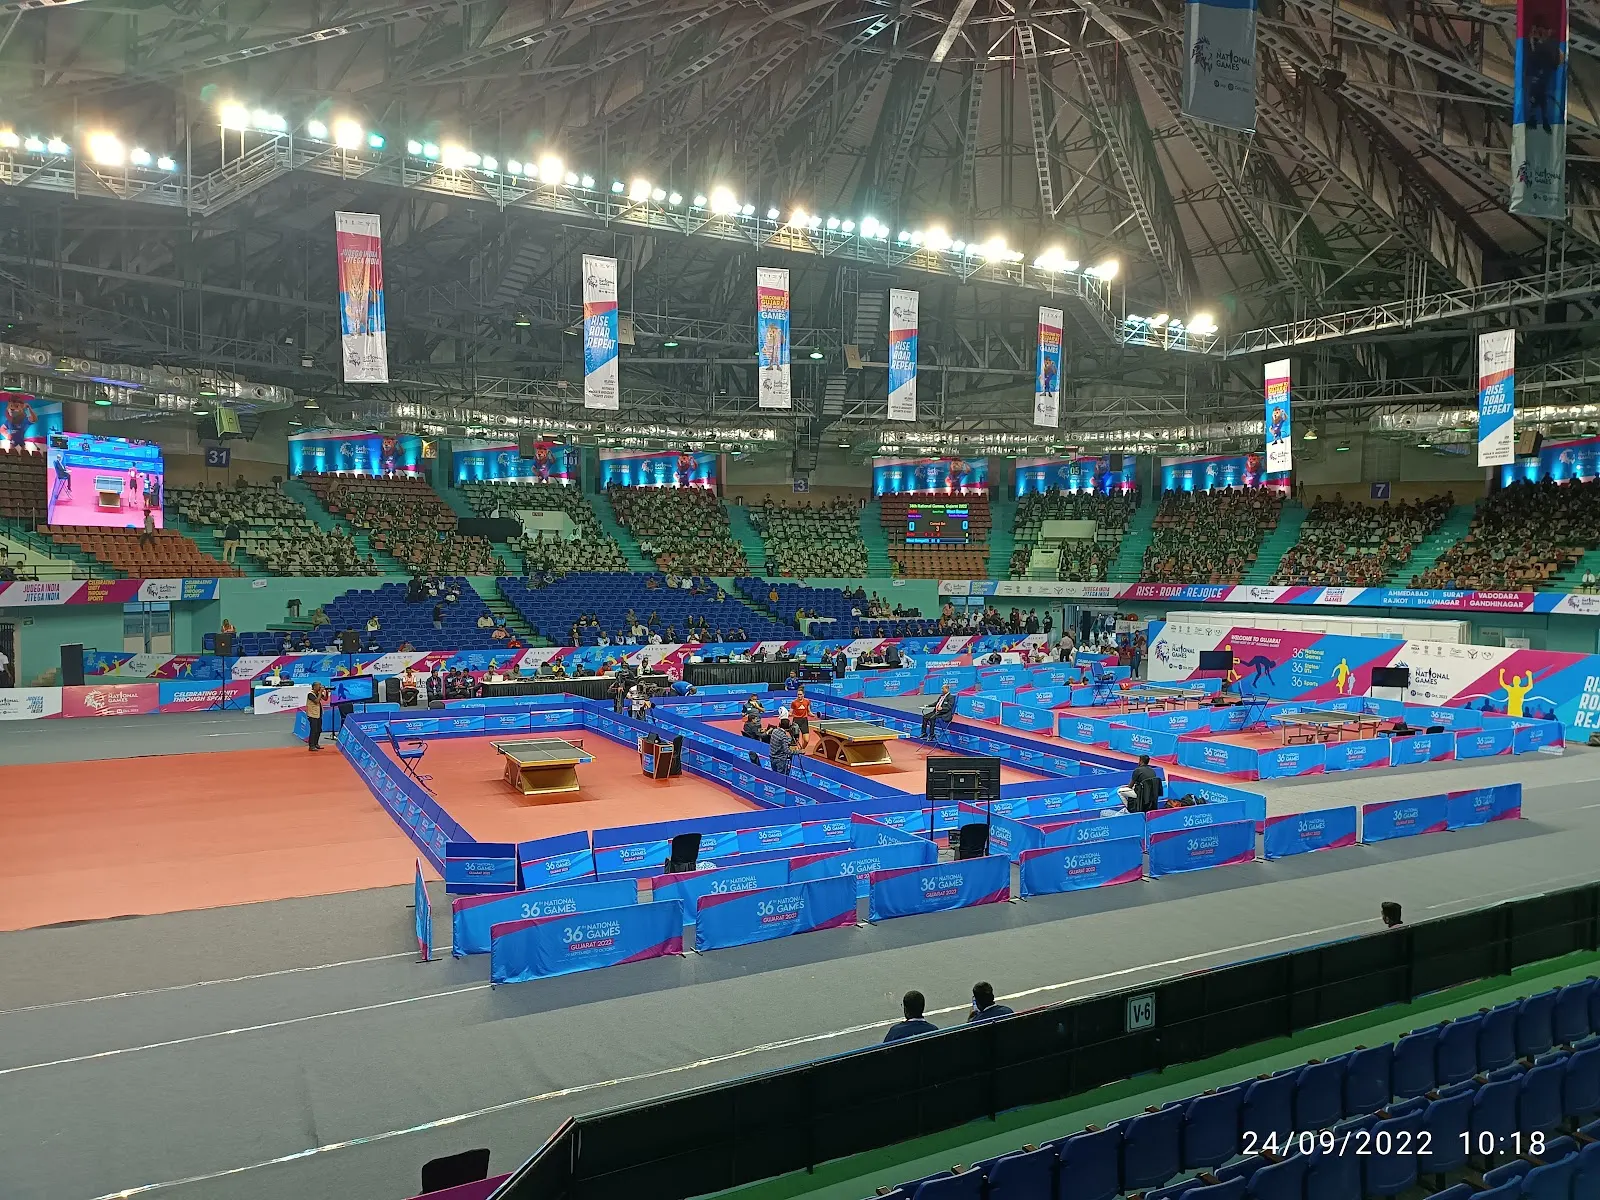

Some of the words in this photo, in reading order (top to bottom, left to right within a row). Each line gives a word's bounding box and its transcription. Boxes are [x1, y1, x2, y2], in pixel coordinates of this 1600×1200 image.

[1216, 49, 1251, 66] NATIONAL
[1216, 60, 1239, 71] GAMES
[591, 314, 609, 327] RISE
[761, 311, 786, 320] GAMES
[589, 325, 610, 338] ROAR
[587, 336, 616, 350] REPEAT
[895, 341, 910, 351] RISE
[893, 350, 911, 361] ROAR
[891, 360, 915, 371] REPEAT
[1485, 383, 1504, 395] RISE
[1483, 393, 1505, 406] ROAR
[1482, 403, 1512, 416] REPEAT
[208, 449, 227, 465] 31
[1070, 466, 1080, 475] 05
[799, 480, 806, 491] 3
[1375, 483, 1386, 496] 7
[909, 521, 915, 531] 0
[962, 520, 968, 530] 0
[23, 584, 44, 592] JUDEGA
[44, 584, 60, 592] INDIA
[1136, 586, 1155, 597] RISE
[1160, 586, 1182, 597] ROAR
[1187, 587, 1222, 598] REJOICE
[25, 593, 45, 601] JITEGA
[45, 592, 60, 601] INDIA
[1478, 592, 1519, 600] VADODARA
[1418, 598, 1460, 606] BHAVNAGAR
[1470, 600, 1523, 608] GANDHINAGAR
[1172, 644, 1195, 654] NATIONAL
[1292, 647, 1303, 658] 36
[1292, 662, 1303, 673] 36
[1415, 667, 1450, 680] NATIONAL
[1291, 676, 1302, 687] 36
[1415, 677, 1437, 685] GAMES
[1584, 675, 1600, 692] RI
[108, 691, 138, 699] NATIONAL
[1579, 692, 1600, 710] RO
[1204, 747, 1212, 756] 36
[1276, 754, 1285, 763] 36
[1199, 789, 1209, 800] 36
[1195, 816, 1213, 825] GAMES
[1393, 810, 1402, 820] 36
[1183, 815, 1194, 827] 36
[1298, 820, 1308, 832] 36
[1309, 822, 1325, 830] GAMES
[759, 830, 767, 839] 36
[996, 825, 1011, 834] NATIONAL
[1077, 829, 1089, 840] 36
[1090, 830, 1109, 839] GAMES
[878, 833, 887, 845] 36
[996, 830, 1012, 842] GAMES
[1187, 839, 1199, 851] 36
[1200, 840, 1219, 848] GAMES
[620, 850, 629, 858] 36
[556, 860, 571, 868] GAMES
[1064, 856, 1077, 868] 36
[1080, 852, 1100, 860] NATIONAL
[1079, 857, 1101, 866] GAMES
[465, 862, 476, 870] 36
[546, 862, 555, 870] 36
[840, 862, 854, 875] 36
[856, 857, 881, 865] NATIONAL
[856, 864, 881, 873] GAMES
[731, 876, 757, 884] NATIONAL
[921, 877, 935, 891] 36
[938, 873, 962, 881] NATIONAL
[938, 879, 963, 889] GAMES
[730, 881, 758, 892] GAMES
[544, 897, 576, 907] NATIONAL
[778, 895, 805, 904] NATIONAL
[544, 904, 577, 915] GAMES
[777, 901, 805, 913] GAMES
[763, 914, 785, 923] GUJARAT
[587, 920, 620, 930] NATIONAL
[587, 926, 621, 939] GAMES
[570, 941, 596, 951] GUJARAT
[597, 939, 613, 947] 2022
